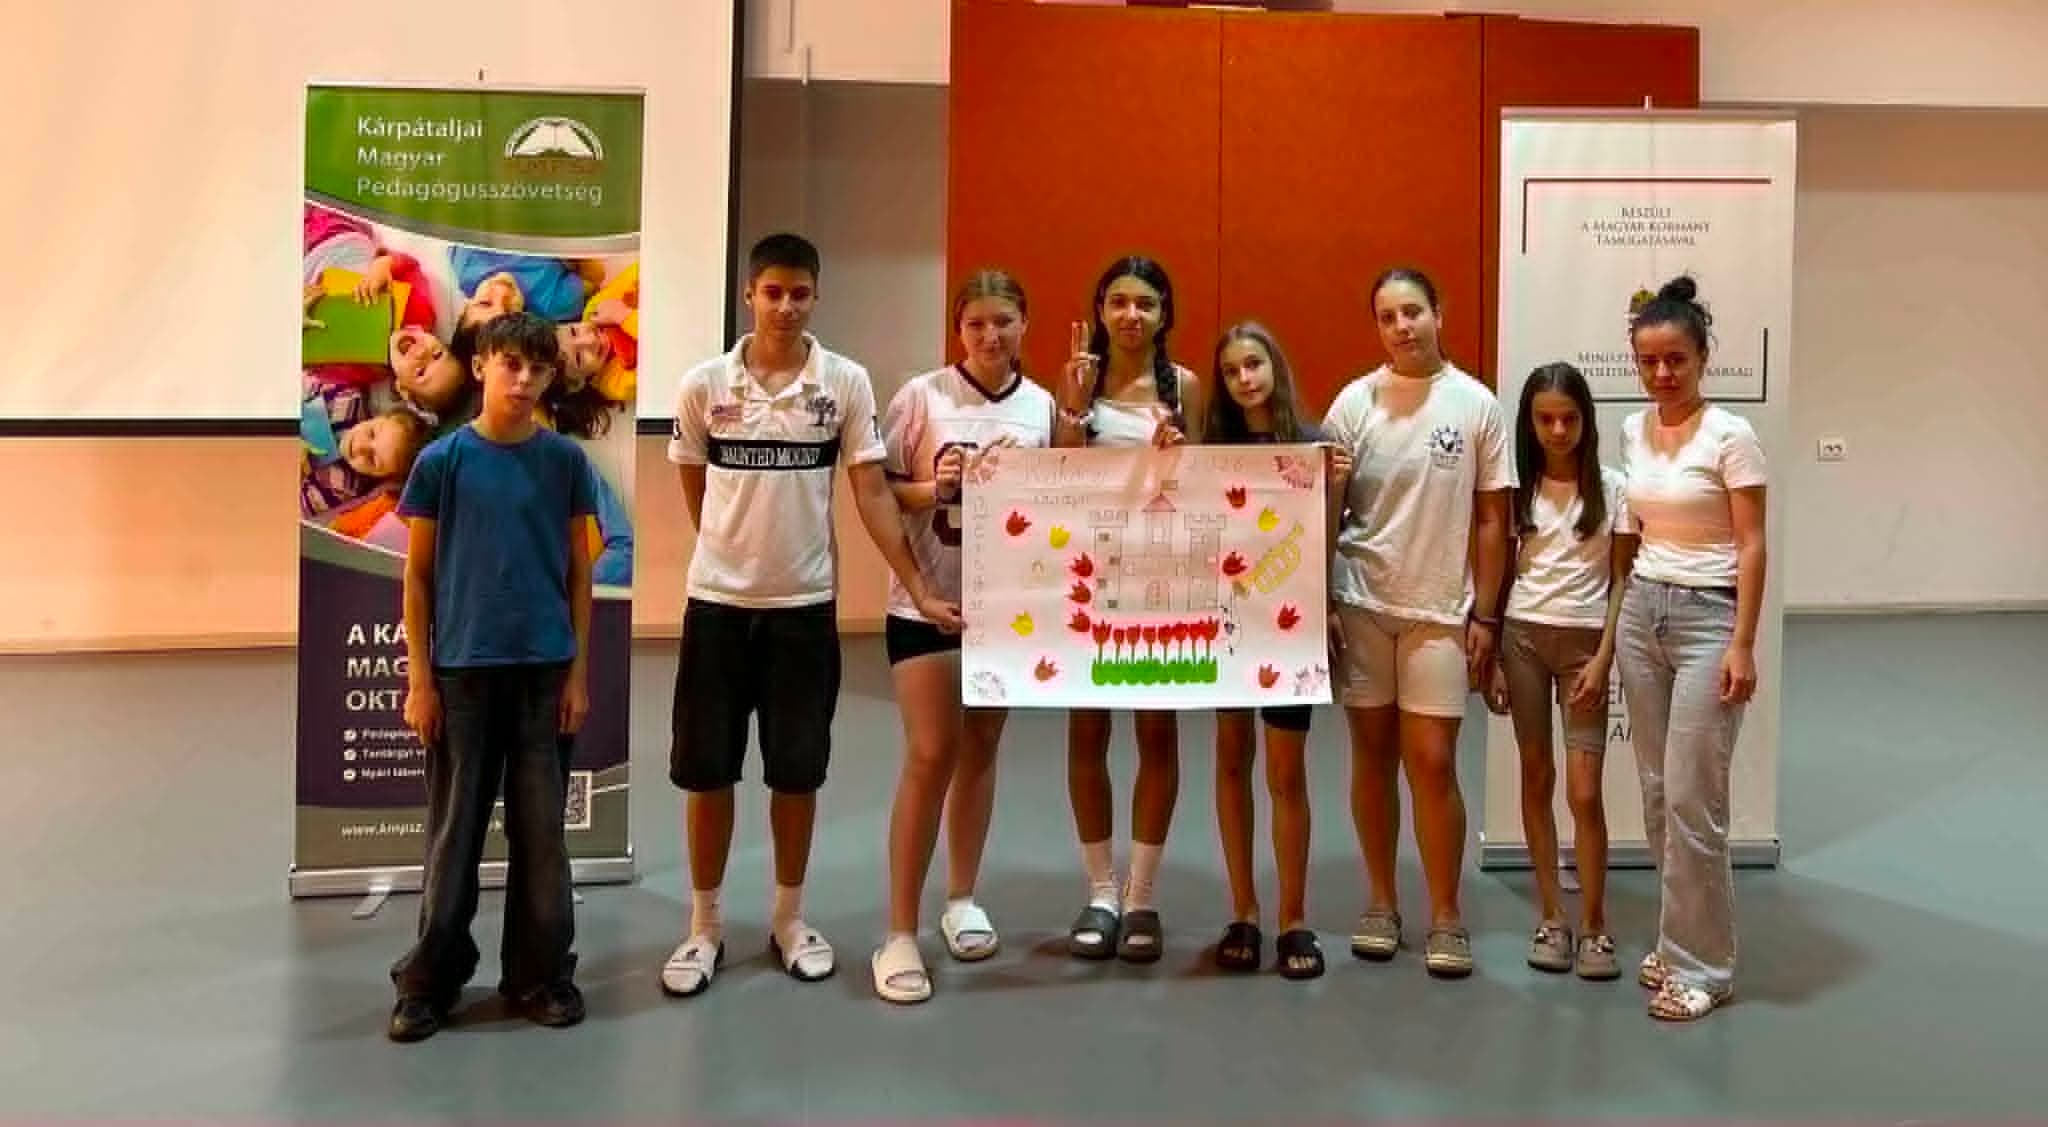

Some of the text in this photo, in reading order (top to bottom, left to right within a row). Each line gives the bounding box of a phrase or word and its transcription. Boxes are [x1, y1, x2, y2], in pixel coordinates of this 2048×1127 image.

[358, 115, 482, 142] Kárpátaljai
[358, 146, 446, 172] Magyar
[357, 176, 602, 208] Pedagógusszövetség
[347, 623, 366, 645] A
[346, 656, 409, 679] MAG
[345, 689, 403, 711] OKT
